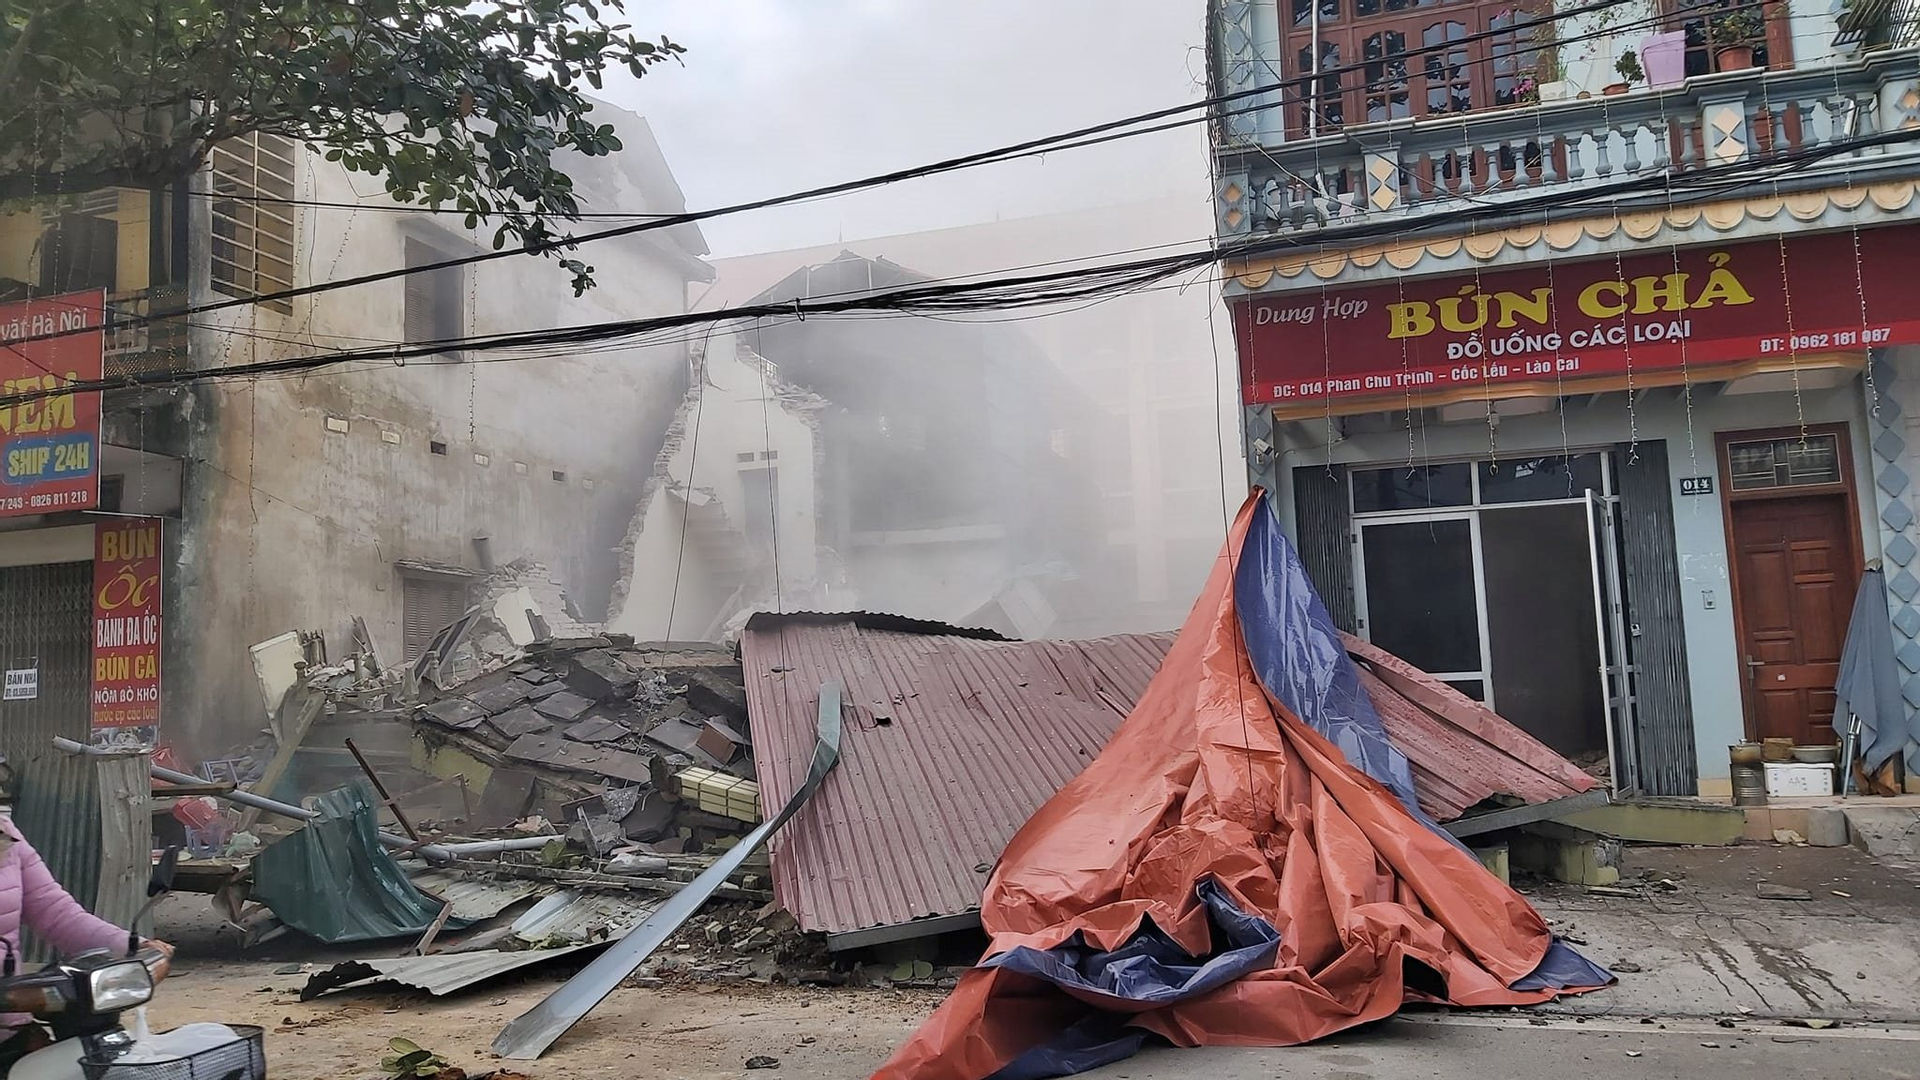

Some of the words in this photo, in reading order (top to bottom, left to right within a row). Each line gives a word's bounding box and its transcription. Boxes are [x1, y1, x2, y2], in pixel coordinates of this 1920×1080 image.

[1256, 306, 1315, 325] Dung
[1323, 297, 1368, 319] Hợp
[1386, 285, 1552, 339] BÚN
[1578, 252, 1754, 318] CHẢ
[1491, 328, 1563, 355] UỐNG
[1569, 323, 1626, 348] CÁC
[1634, 319, 1692, 344] LOẠI
[1760, 338, 1784, 353] ĐT:
[1790, 333, 1829, 350] 0962
[1832, 331, 1857, 346] 181
[1861, 328, 1891, 344] 087
[1273, 385, 1296, 398] ĐC:
[1300, 381, 1323, 395] 014
[1326, 378, 1361, 393] Phan
[1365, 373, 1392, 389] Chu
[1395, 370, 1434, 388] Trinh
[1451, 364, 1479, 381] Cốc
[1483, 361, 1508, 378] Lếu
[1526, 359, 1551, 375] Lào
[1556, 357, 1580, 371] Cai
[8, 447, 50, 477] SHIP
[54, 442, 90, 472] 24H
[31, 494, 52, 507] 0826
[54, 492, 69, 505] 811
[71, 490, 88, 503] 218
[1683, 478, 1709, 490] 014
[102, 524, 155, 562] BÚN
[97, 612, 124, 648] BÁNH
[127, 616, 140, 646] ĐA
[143, 604, 157, 646] ỐC
[96, 652, 130, 681] BÚN
[134, 649, 157, 679] CÁ
[94, 686, 118, 708] NỘM
[119, 685, 134, 702] BÒ
[136, 683, 158, 702] KHÔ
